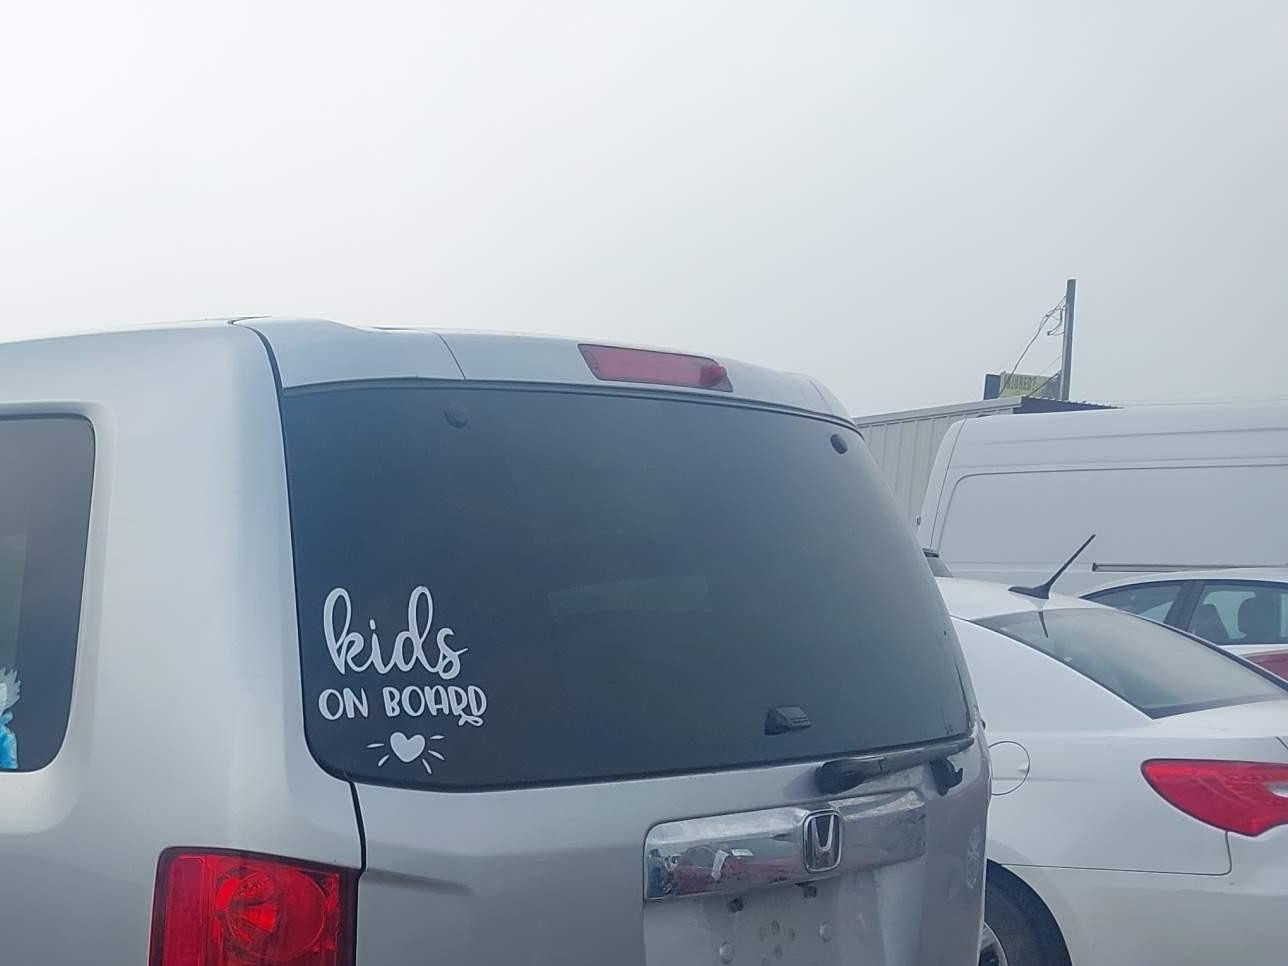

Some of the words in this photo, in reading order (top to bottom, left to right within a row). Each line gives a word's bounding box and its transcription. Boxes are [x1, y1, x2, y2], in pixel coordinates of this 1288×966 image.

[323, 585, 468, 680] kids
[319, 688, 368, 720] ON
[383, 685, 487, 727] BOARD
